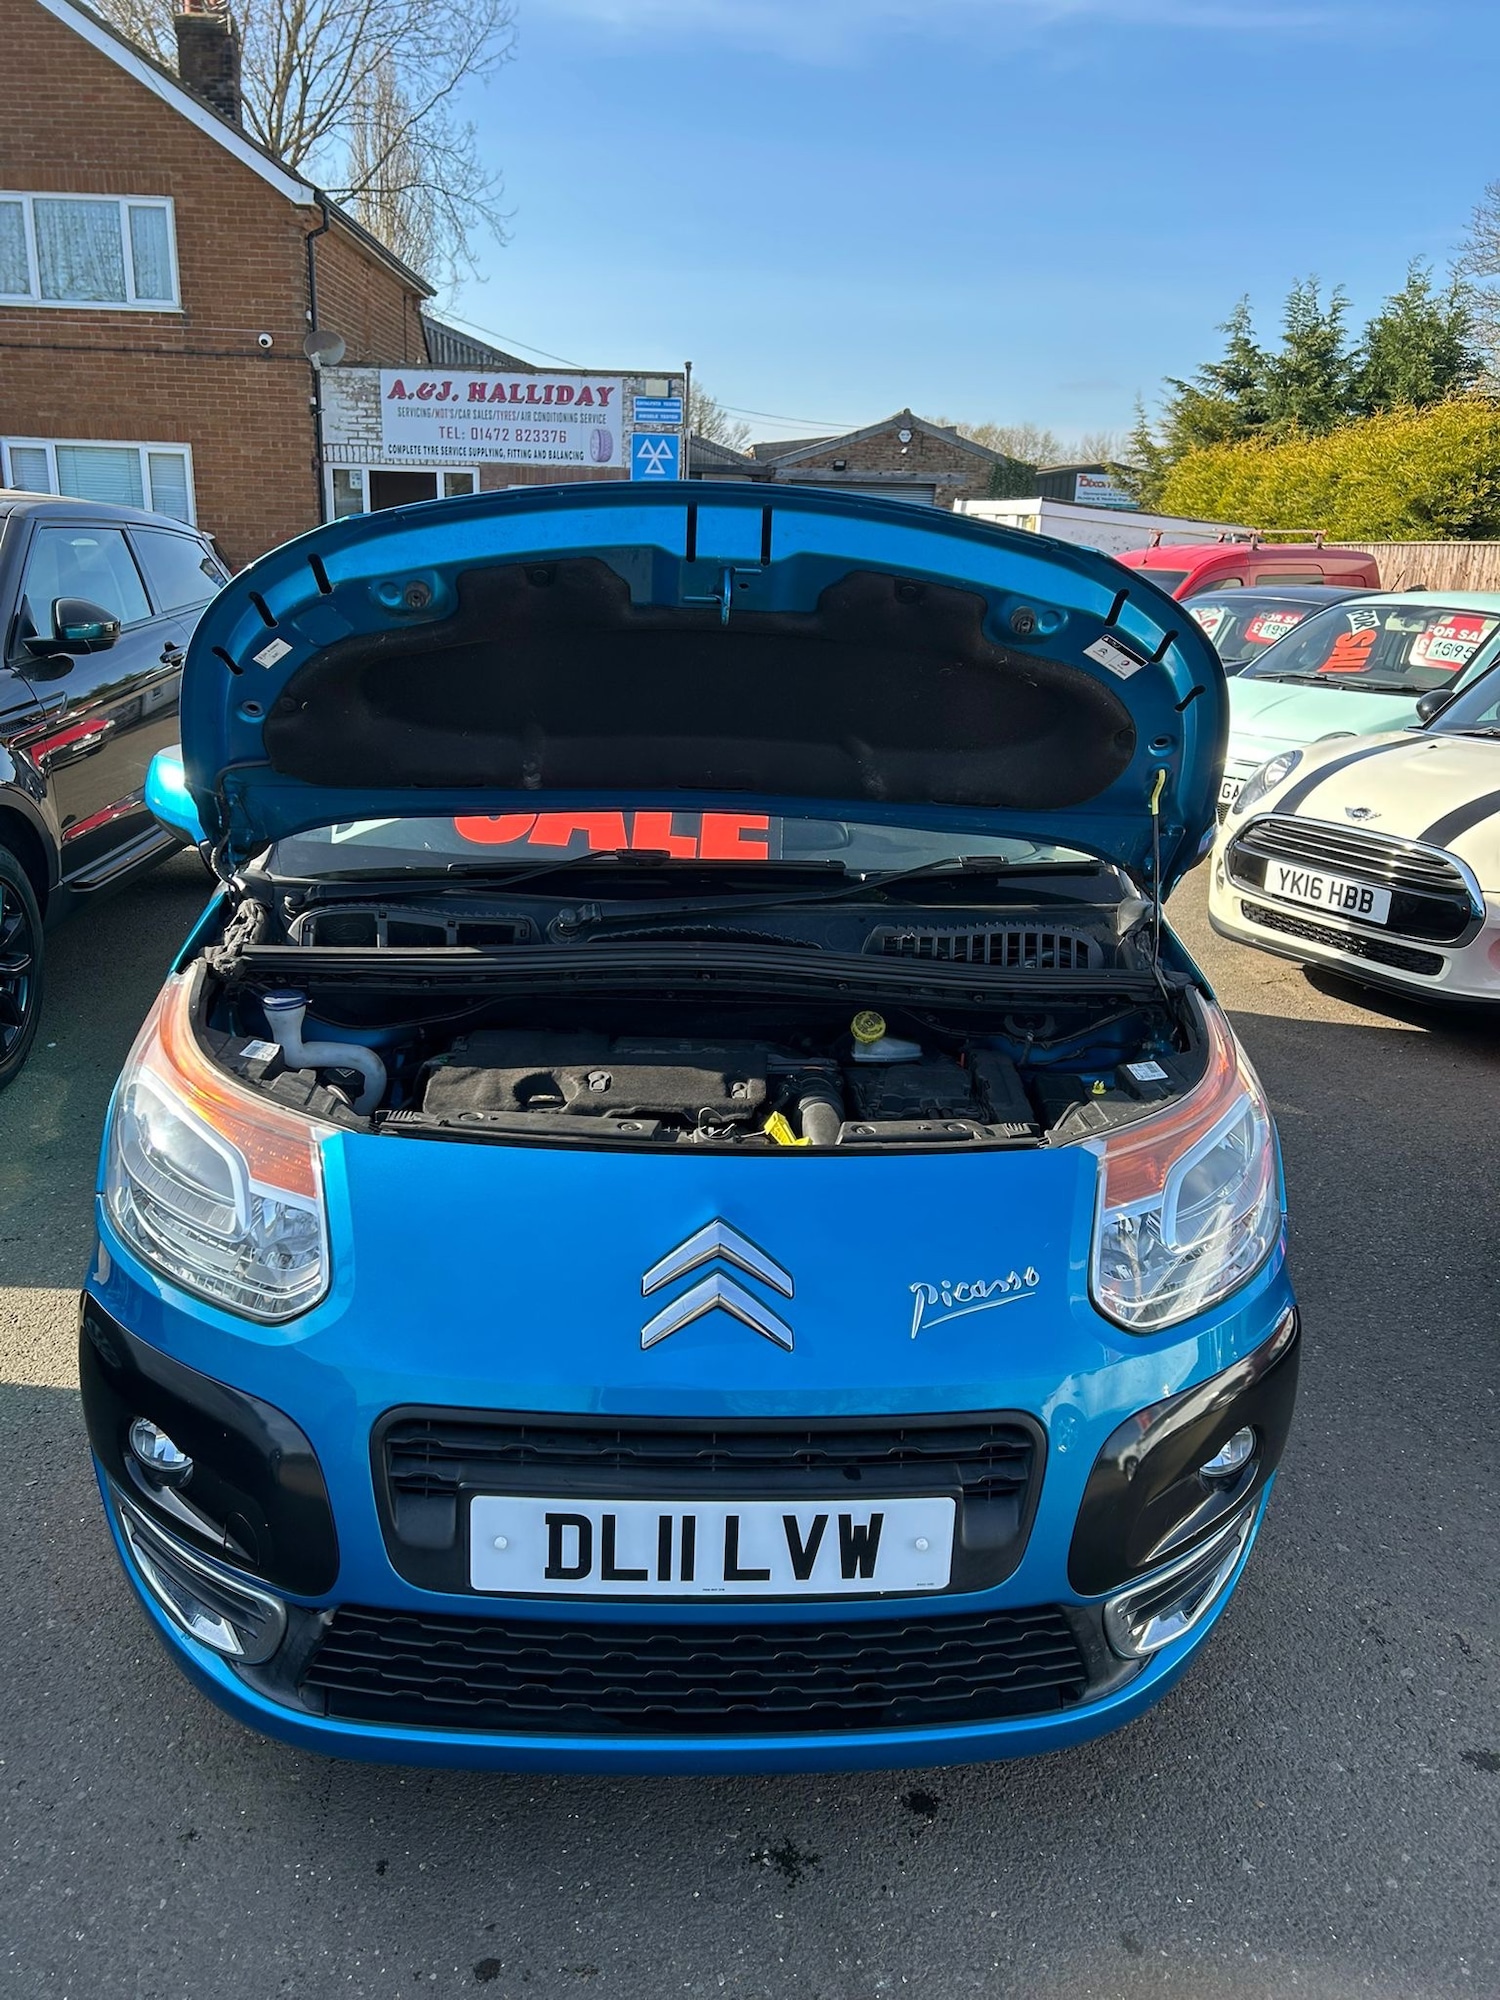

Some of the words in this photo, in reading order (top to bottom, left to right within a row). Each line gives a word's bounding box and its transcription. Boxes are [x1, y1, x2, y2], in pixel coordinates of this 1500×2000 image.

[467, 381, 615, 407] HALLIDAY
[533, 411, 578, 423] CONDITIONING
[580, 413, 607, 425] SERVICE
[439, 426, 466, 440] TEL:
[470, 427, 509, 442] 01472
[515, 429, 567, 443] 823376
[388, 444, 421, 455] COMPLETE
[423, 445, 439, 456] TYRE
[441, 446, 467, 457] SERVICE
[507, 448, 532, 460] FITTING
[533, 449, 547, 459] AND
[548, 450, 585, 461] BALANCING
[1428, 624, 1456, 638] FOR
[1279, 867, 1324, 901] YK16
[1328, 880, 1375, 914] HBB
[544, 1512, 697, 1581] DL11
[723, 1512, 884, 1581] LVW
